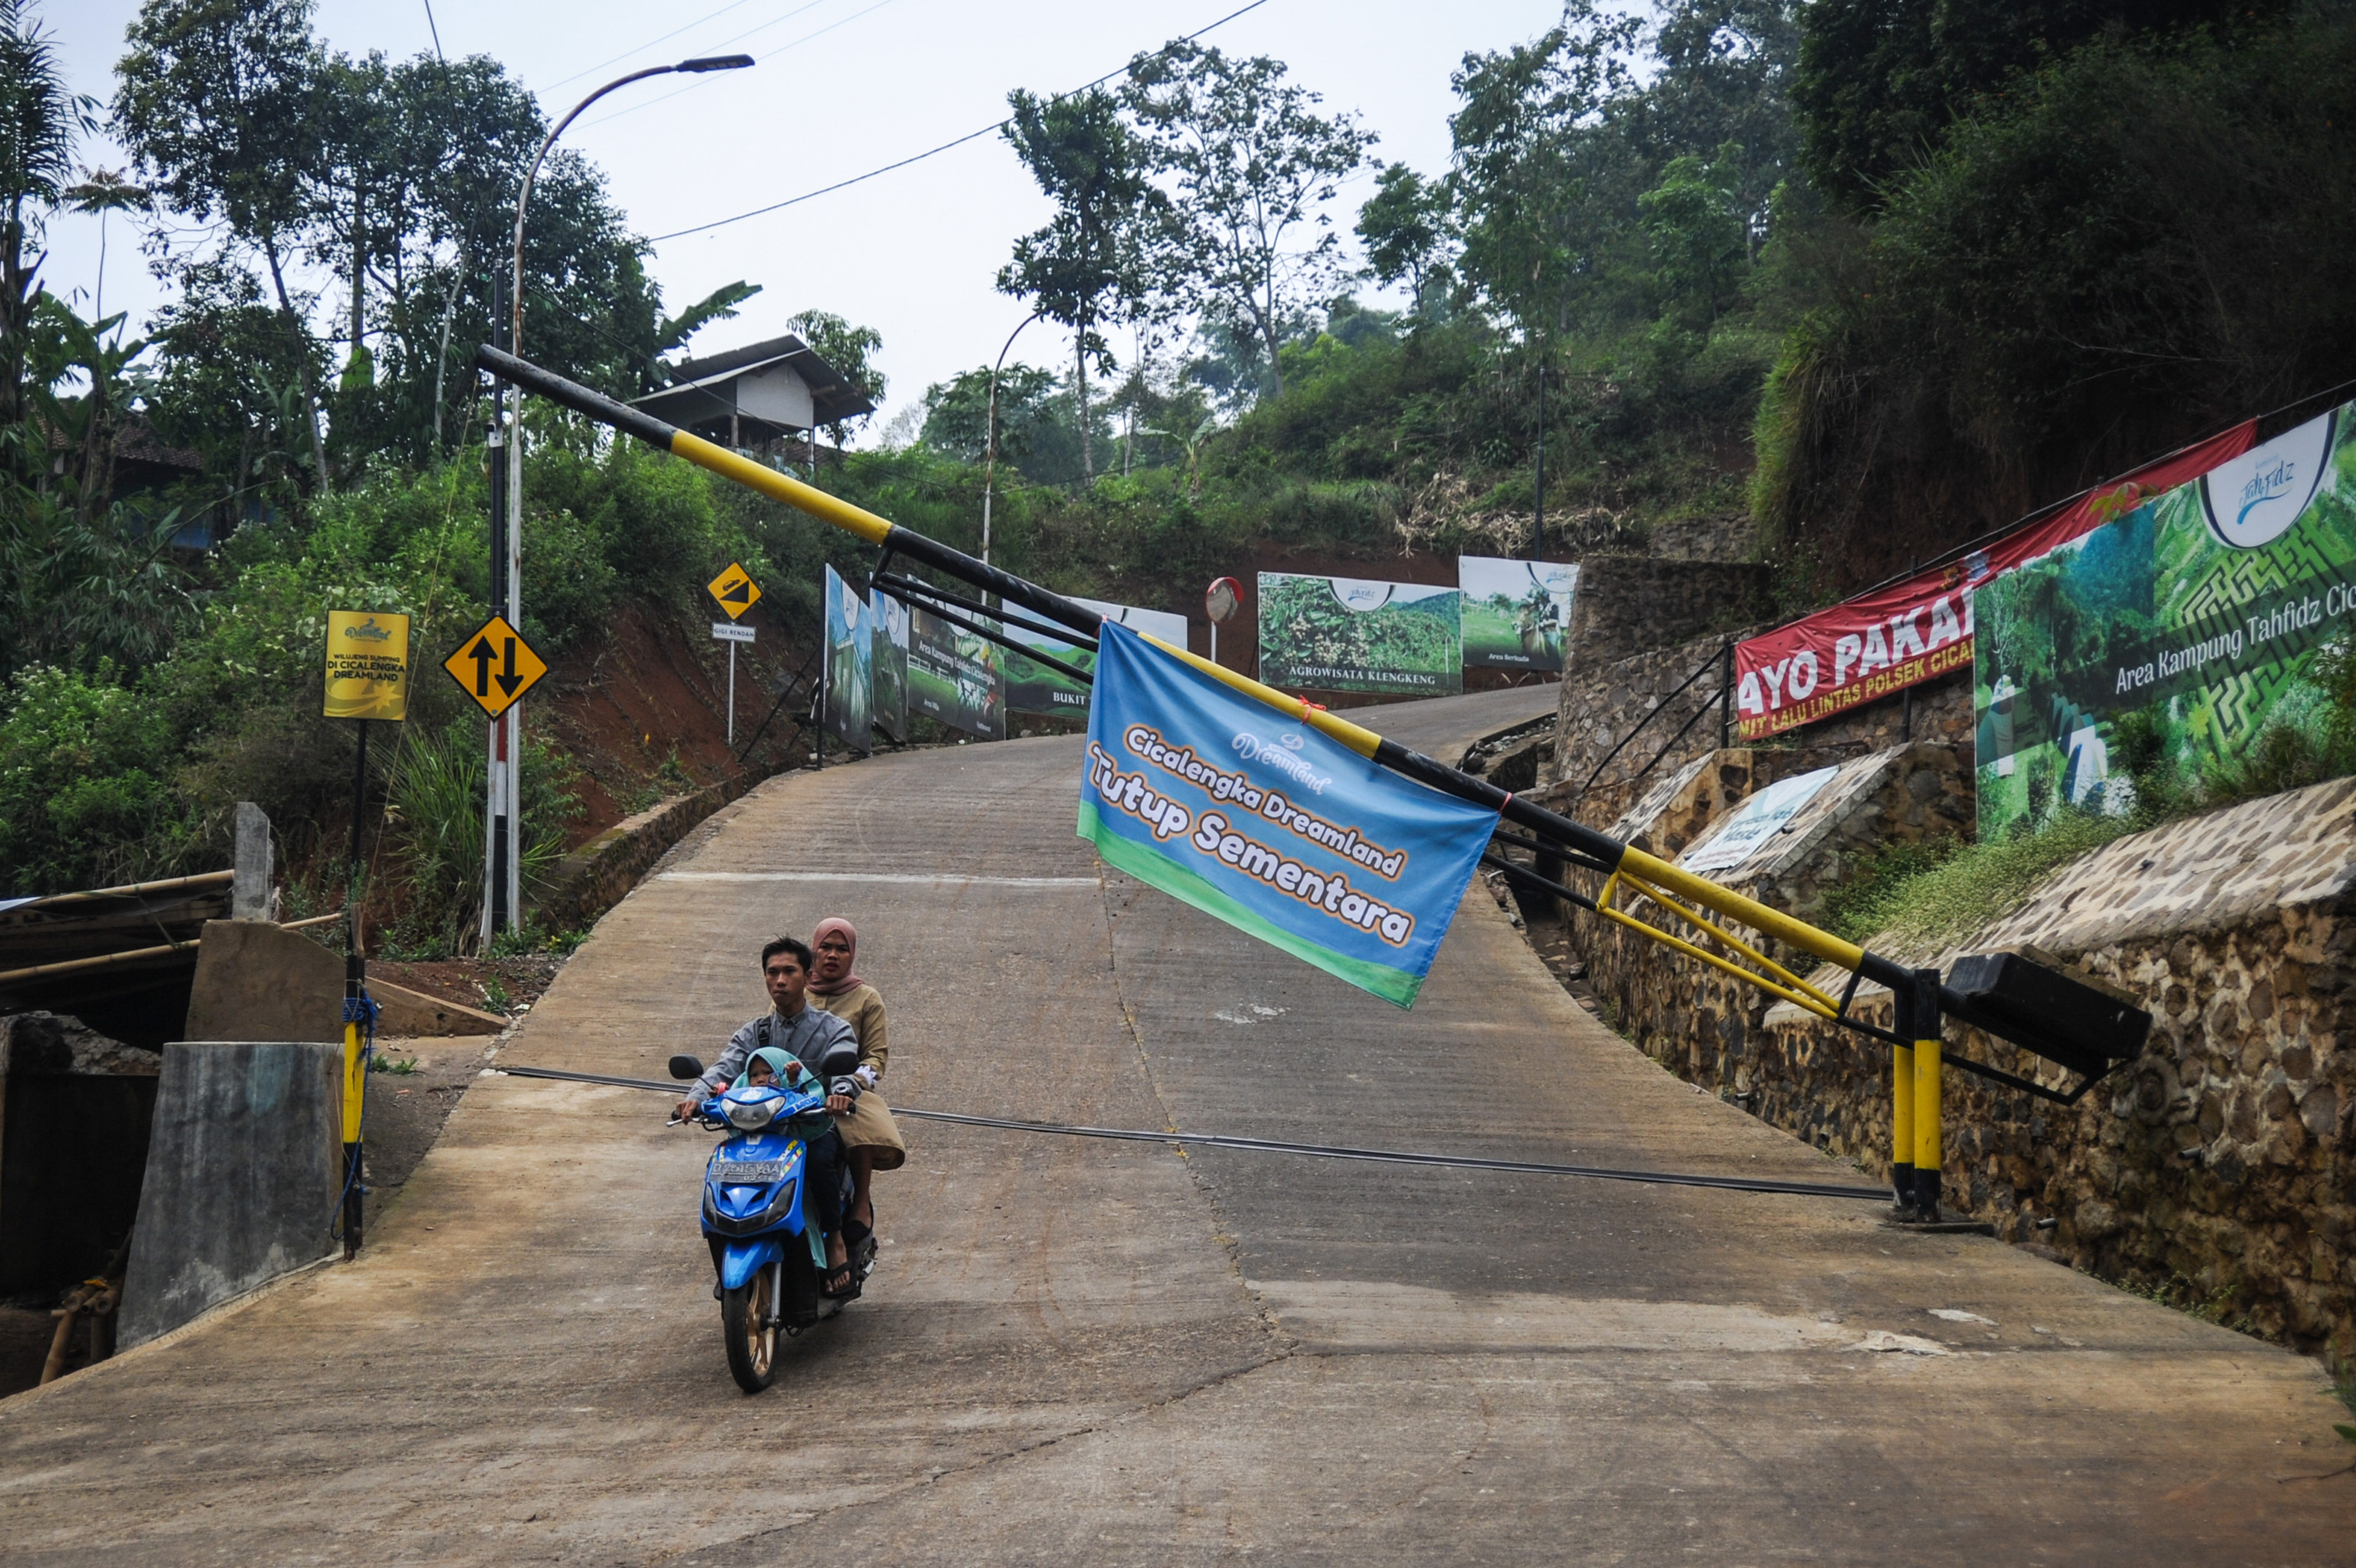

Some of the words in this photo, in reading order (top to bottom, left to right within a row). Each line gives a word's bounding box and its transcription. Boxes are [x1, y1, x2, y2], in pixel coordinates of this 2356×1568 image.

[333, 670, 398, 681] DREAMLAND
[340, 661, 405, 673] CICALENGKA
[919, 640, 931, 654] Area
[1289, 666, 1364, 680] AGROWISATA
[1368, 671, 1436, 685] KLENGKENG
[2116, 662, 2155, 694] Area
[2158, 628, 2243, 679] Kampung
[2246, 596, 2322, 645] Tahfidz
[1053, 692, 1087, 706] BUKIT
[1738, 650, 1818, 714] AYO
[1771, 702, 1807, 731] LALU
[1810, 683, 1861, 718] LINTAS
[1865, 658, 1926, 698] POLSEK
[1231, 732, 1333, 796] Dreamland
[1127, 727, 1262, 809] Cicalengka
[1262, 793, 1404, 878] Dreamland
[1092, 745, 1191, 838] Tutup
[1193, 813, 1412, 944] Sementara
